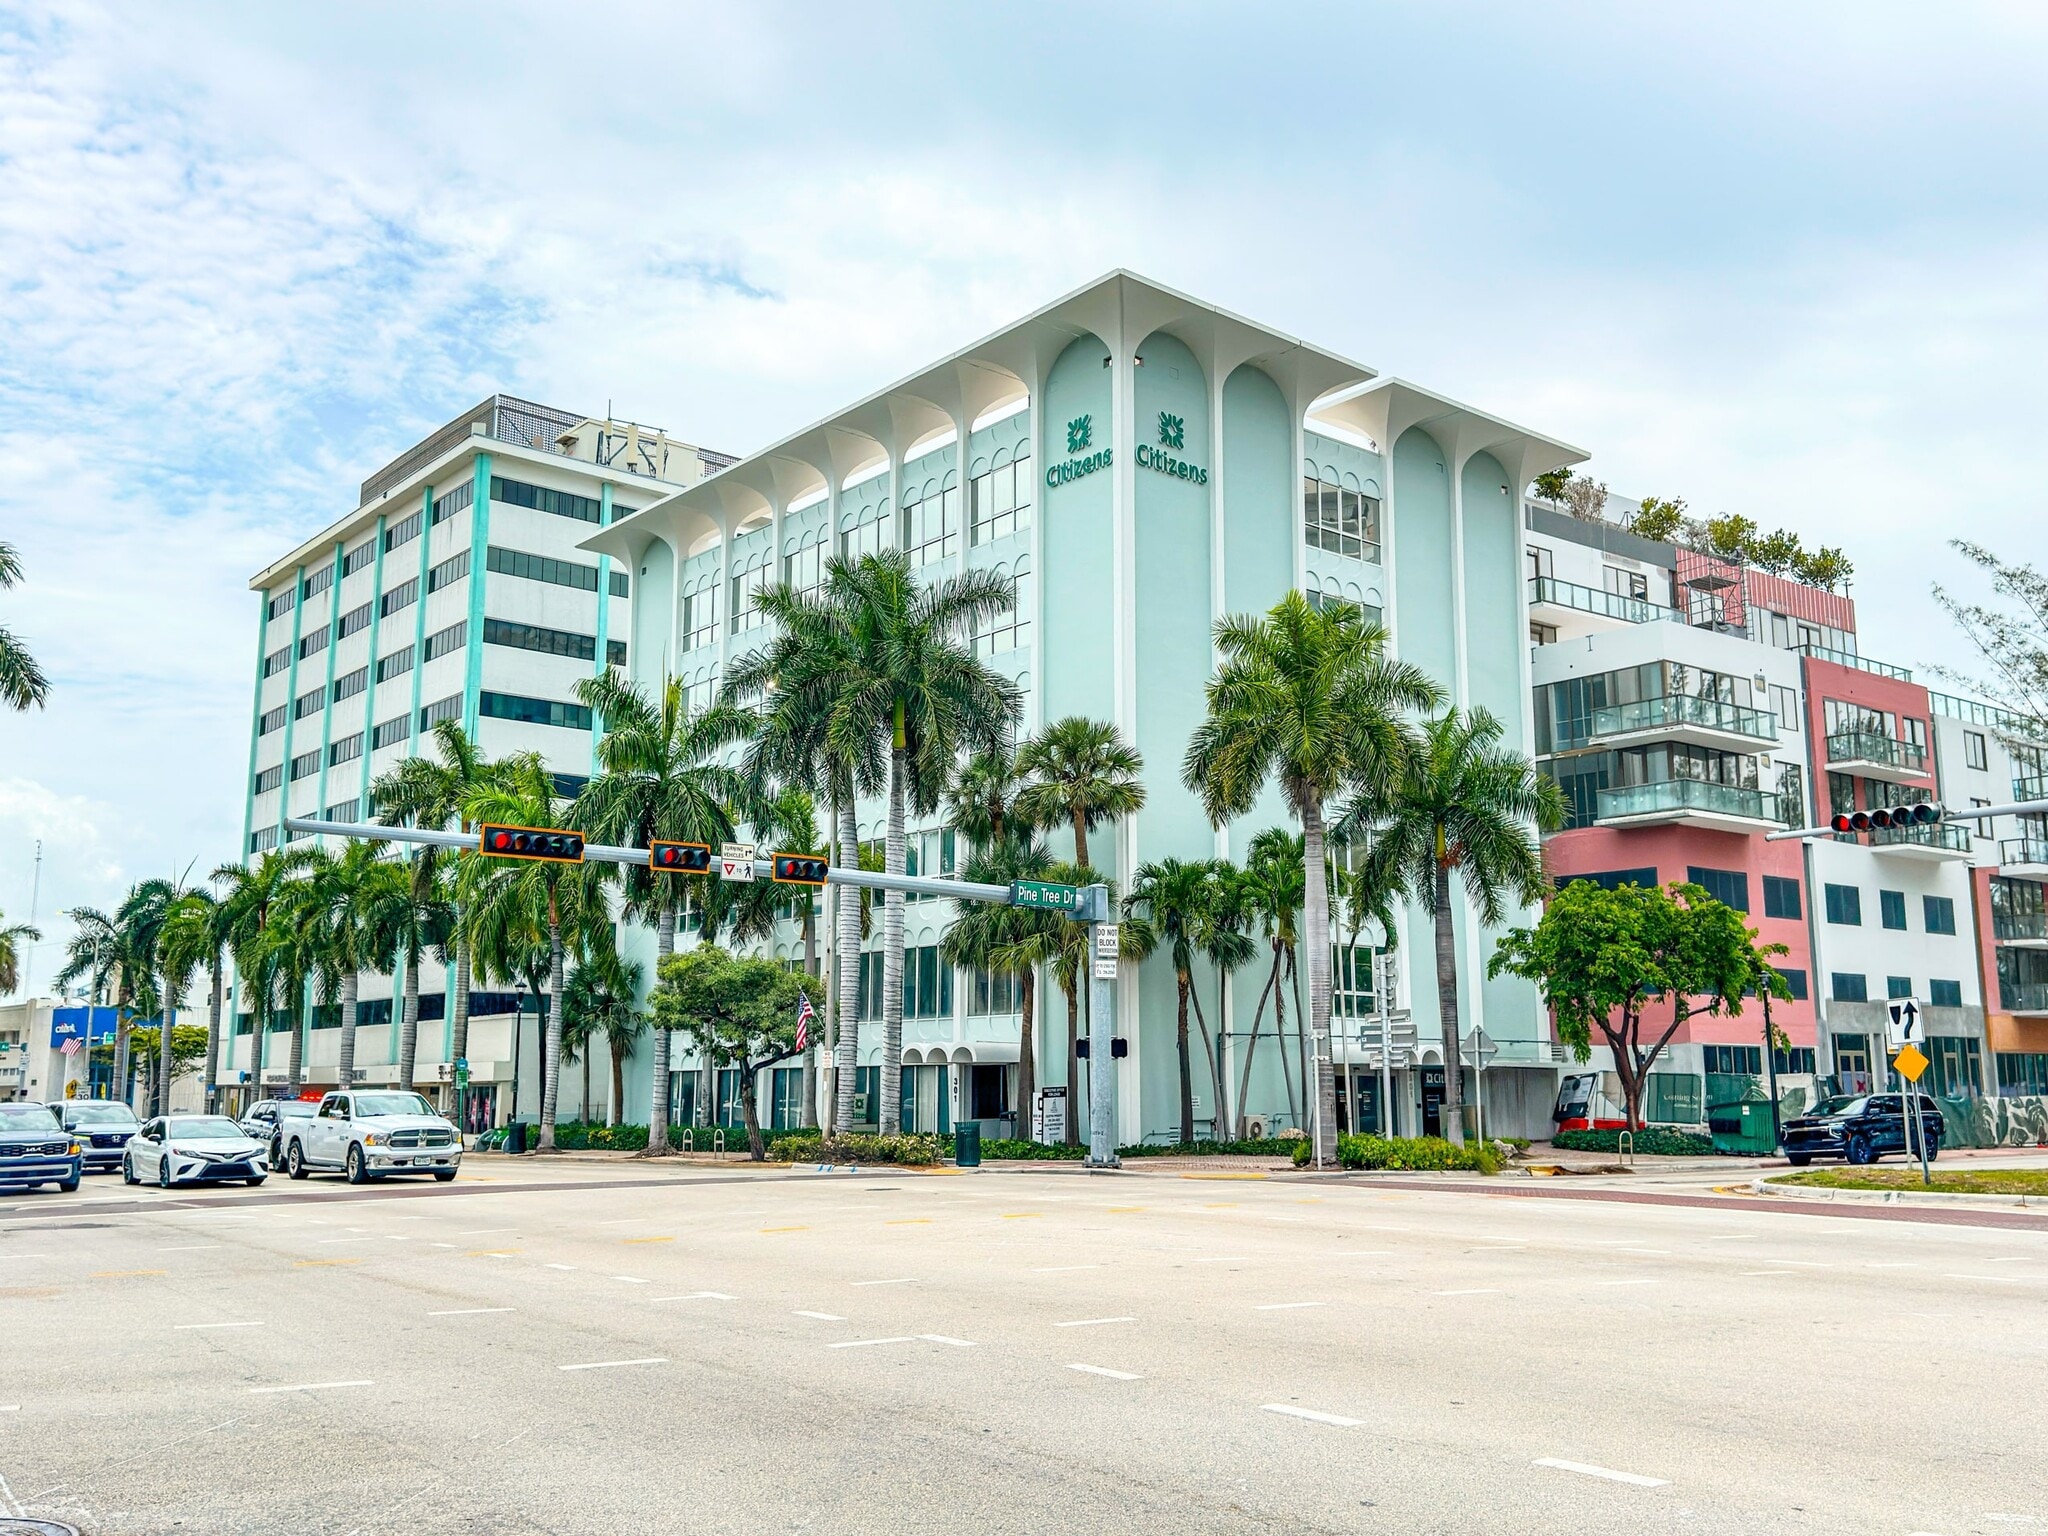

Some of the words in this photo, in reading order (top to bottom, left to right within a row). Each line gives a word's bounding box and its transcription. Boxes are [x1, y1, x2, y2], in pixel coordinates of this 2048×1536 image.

[1046, 448, 1113, 488] Citizens
[1135, 444, 1208, 485] Citizens
[1018, 886, 1037, 901] Pine
[1041, 888, 1060, 903] Tree
[1063, 890, 1074, 904] Dr
[1097, 928, 1106, 936] DO
[1099, 939, 1117, 947] BLOCK
